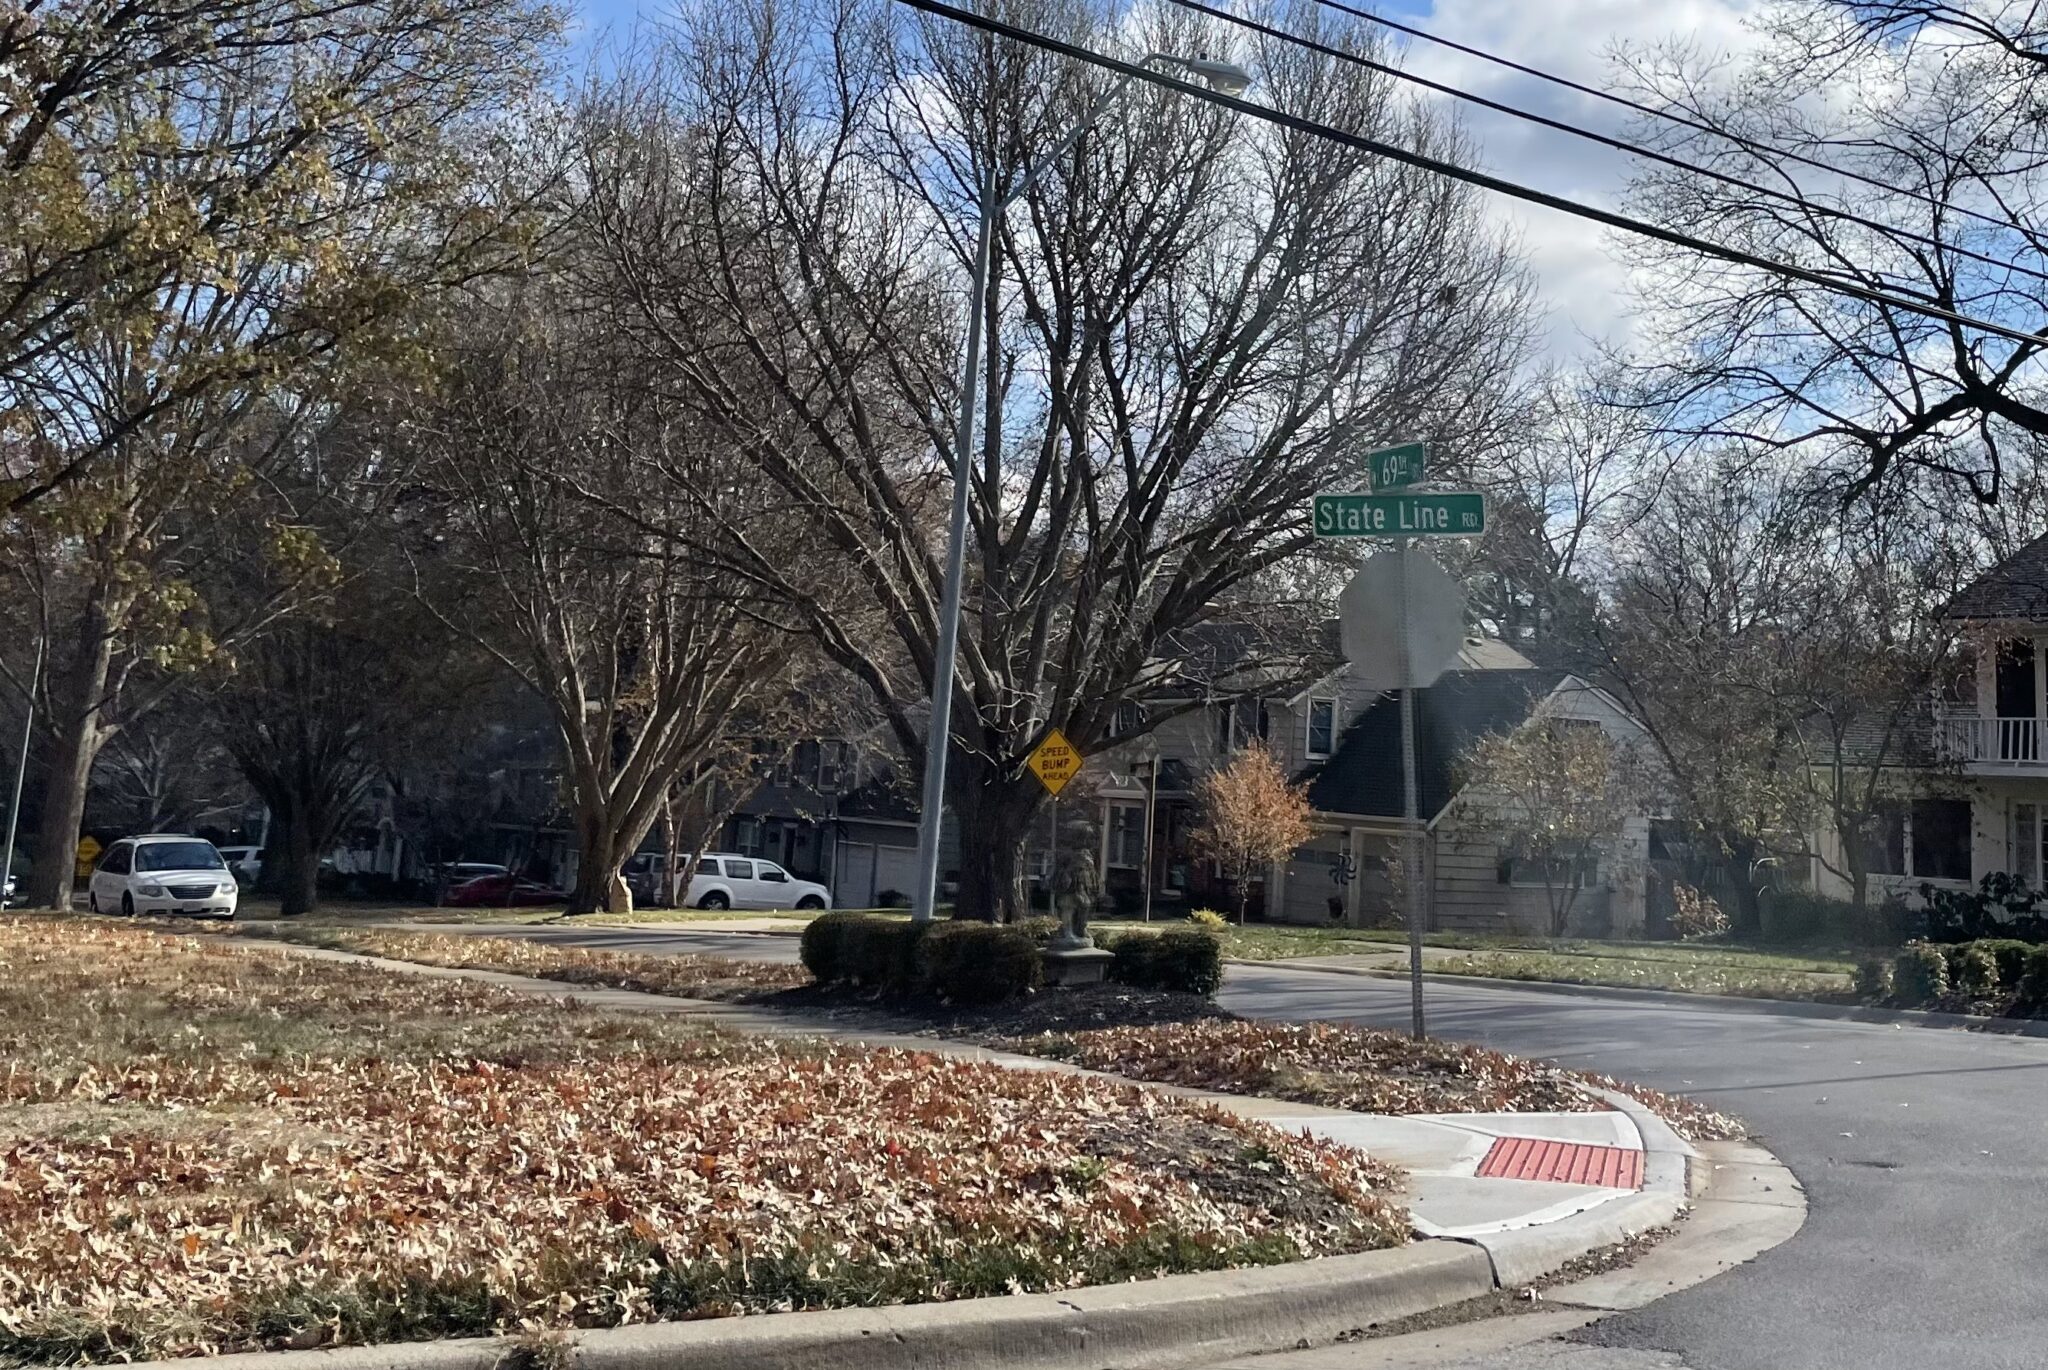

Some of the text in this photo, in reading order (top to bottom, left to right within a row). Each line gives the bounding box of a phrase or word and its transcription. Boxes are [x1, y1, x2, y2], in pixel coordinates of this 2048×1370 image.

[1319, 501, 1478, 531] State Line RD
[1040, 746, 1069, 757] SPEED
[1042, 758, 1070, 770] BUMP
[1042, 772, 1069, 781] AHEAD
